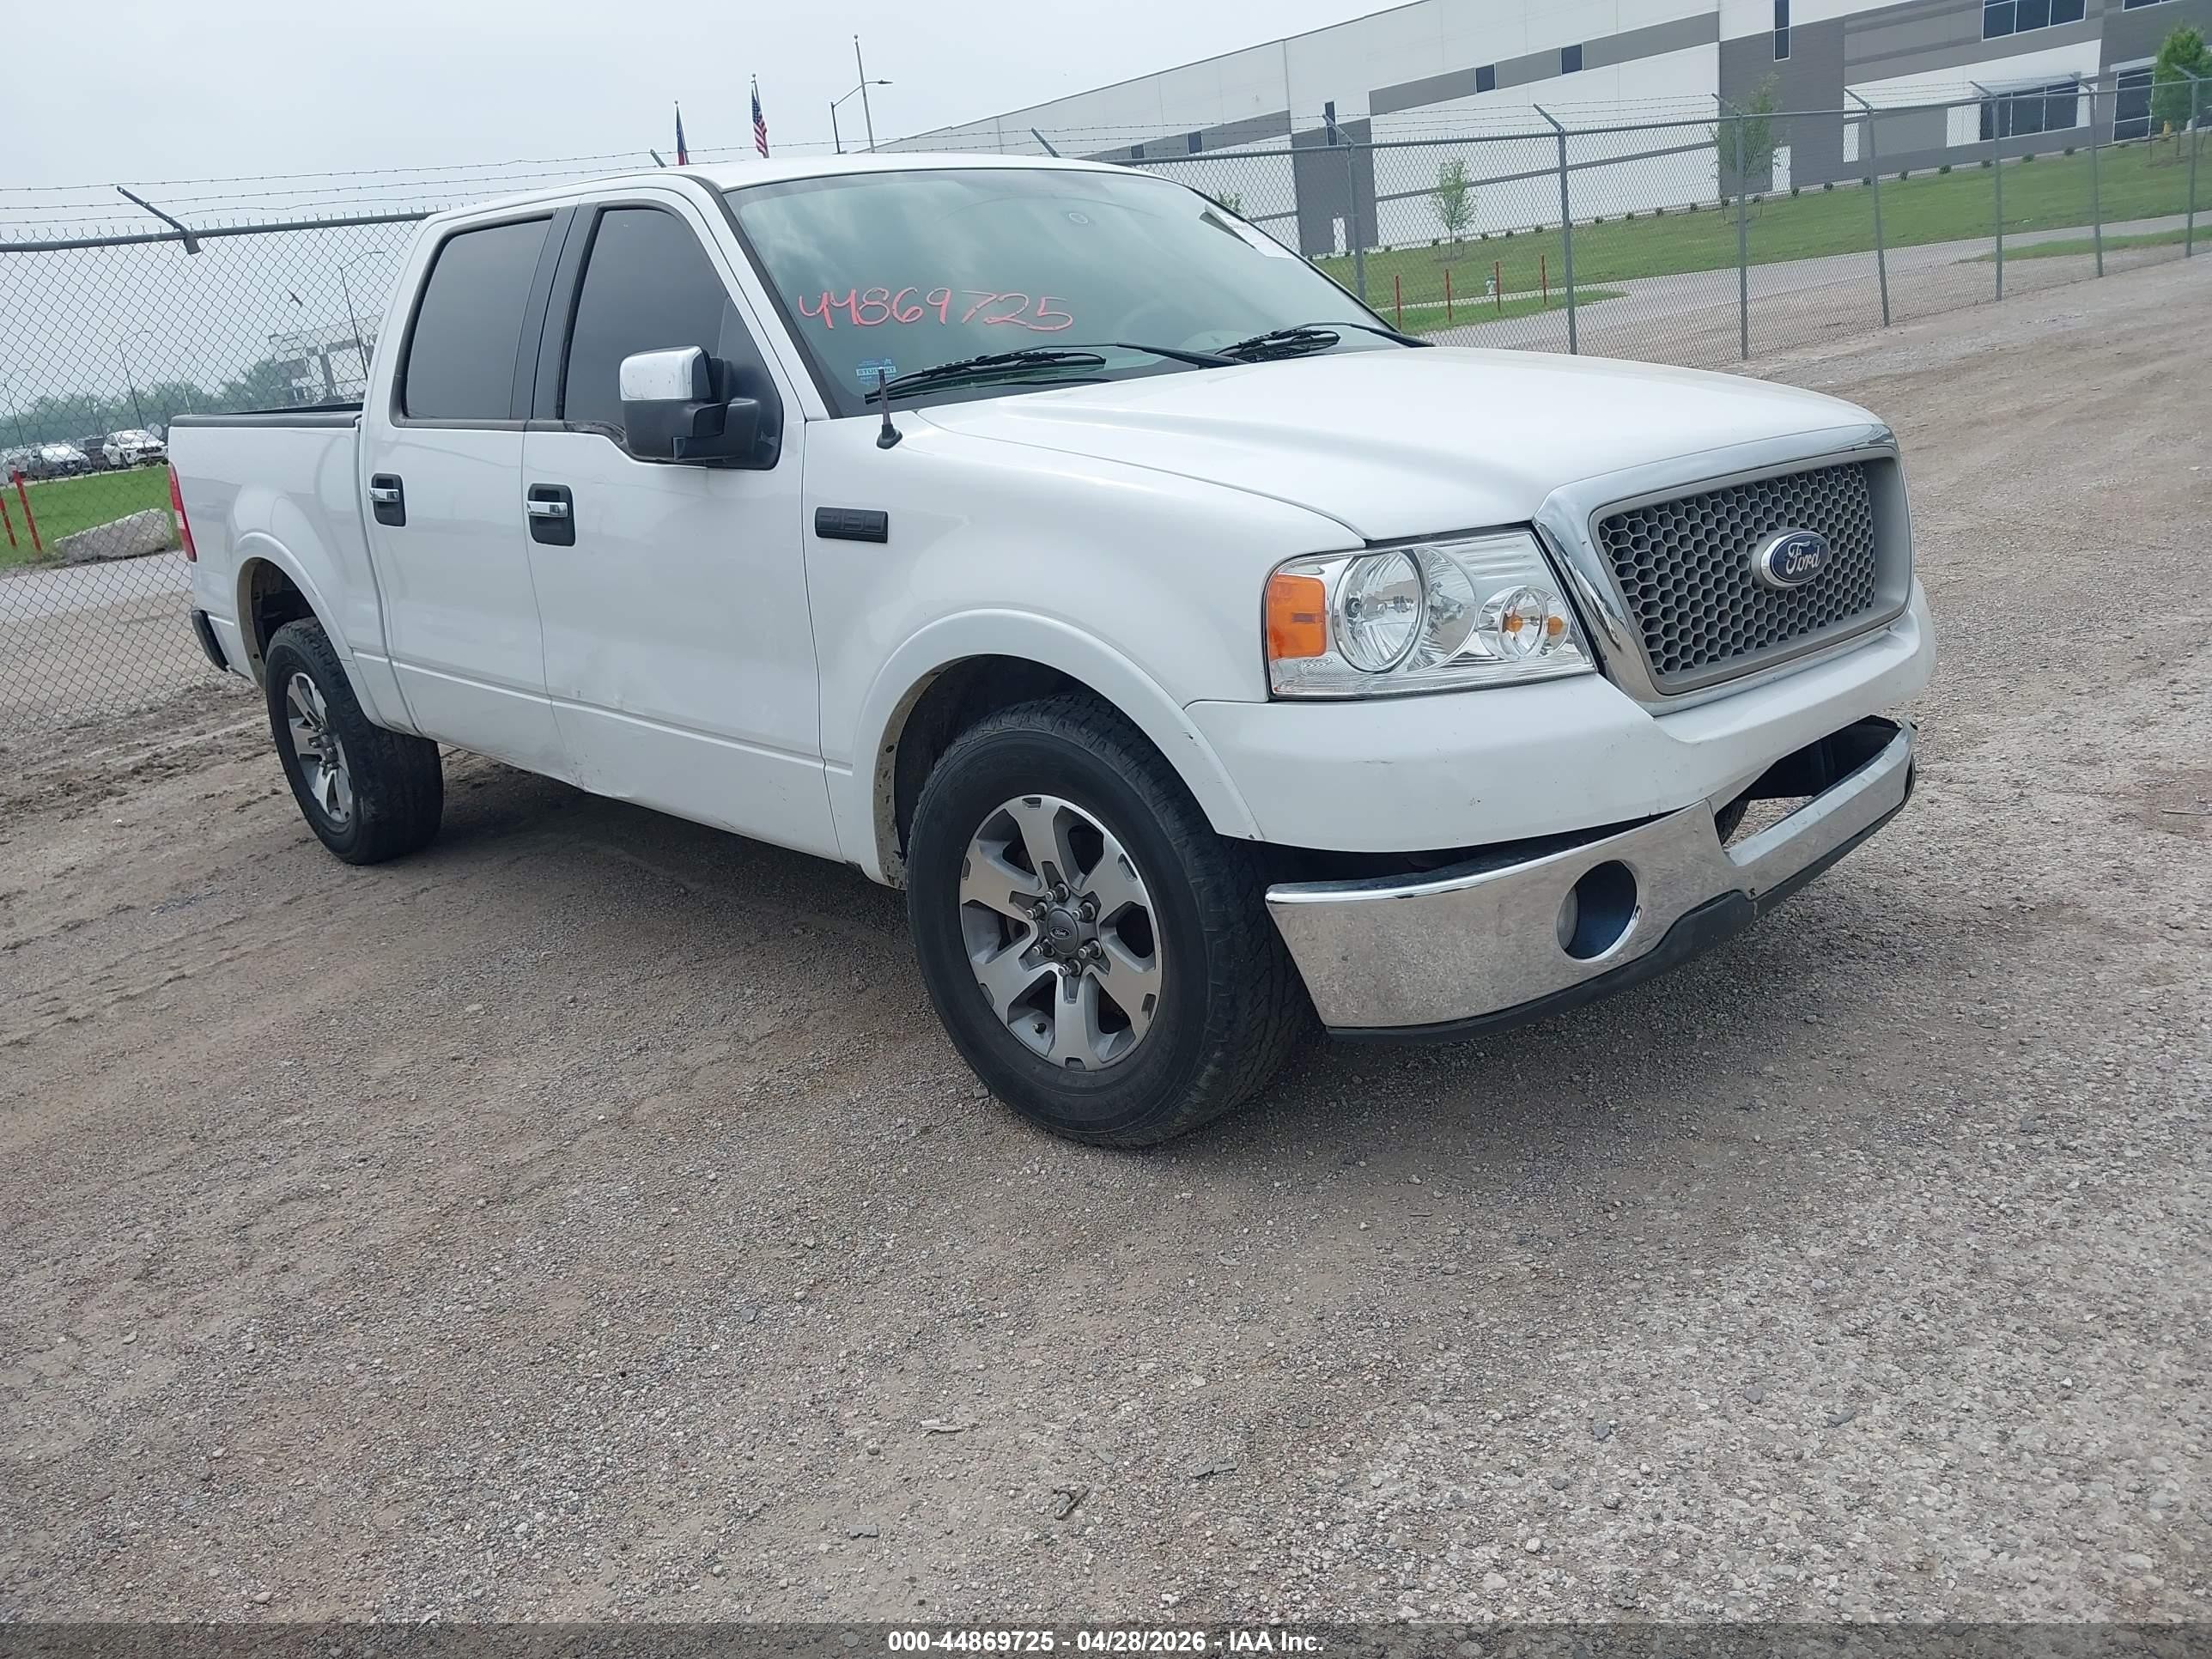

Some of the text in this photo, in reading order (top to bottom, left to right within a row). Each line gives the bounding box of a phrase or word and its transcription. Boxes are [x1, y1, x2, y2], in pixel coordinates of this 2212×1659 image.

[799, 288, 1073, 331] 44869725
[858, 367, 894, 375] STUDNT
[1785, 540, 1820, 574] Ford
